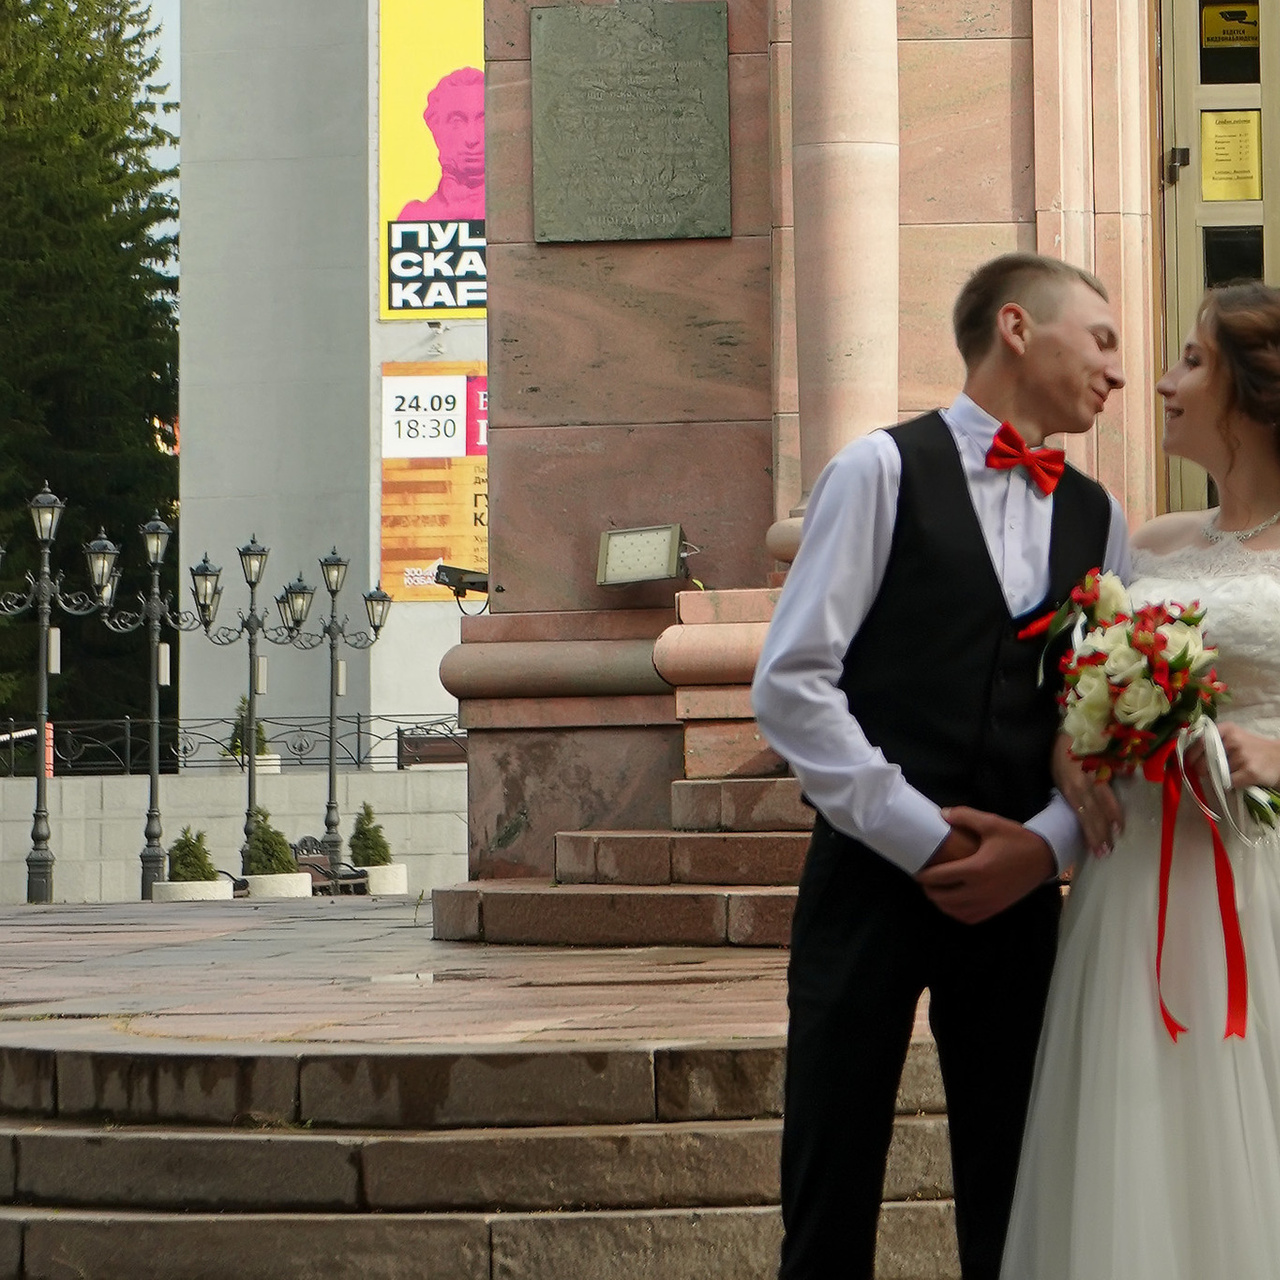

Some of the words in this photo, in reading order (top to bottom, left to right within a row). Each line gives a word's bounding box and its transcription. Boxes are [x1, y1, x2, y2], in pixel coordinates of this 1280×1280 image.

[390, 251, 487, 277] СКА
[394, 394, 457, 412] 24.09
[394, 418, 456, 439] 18:30
